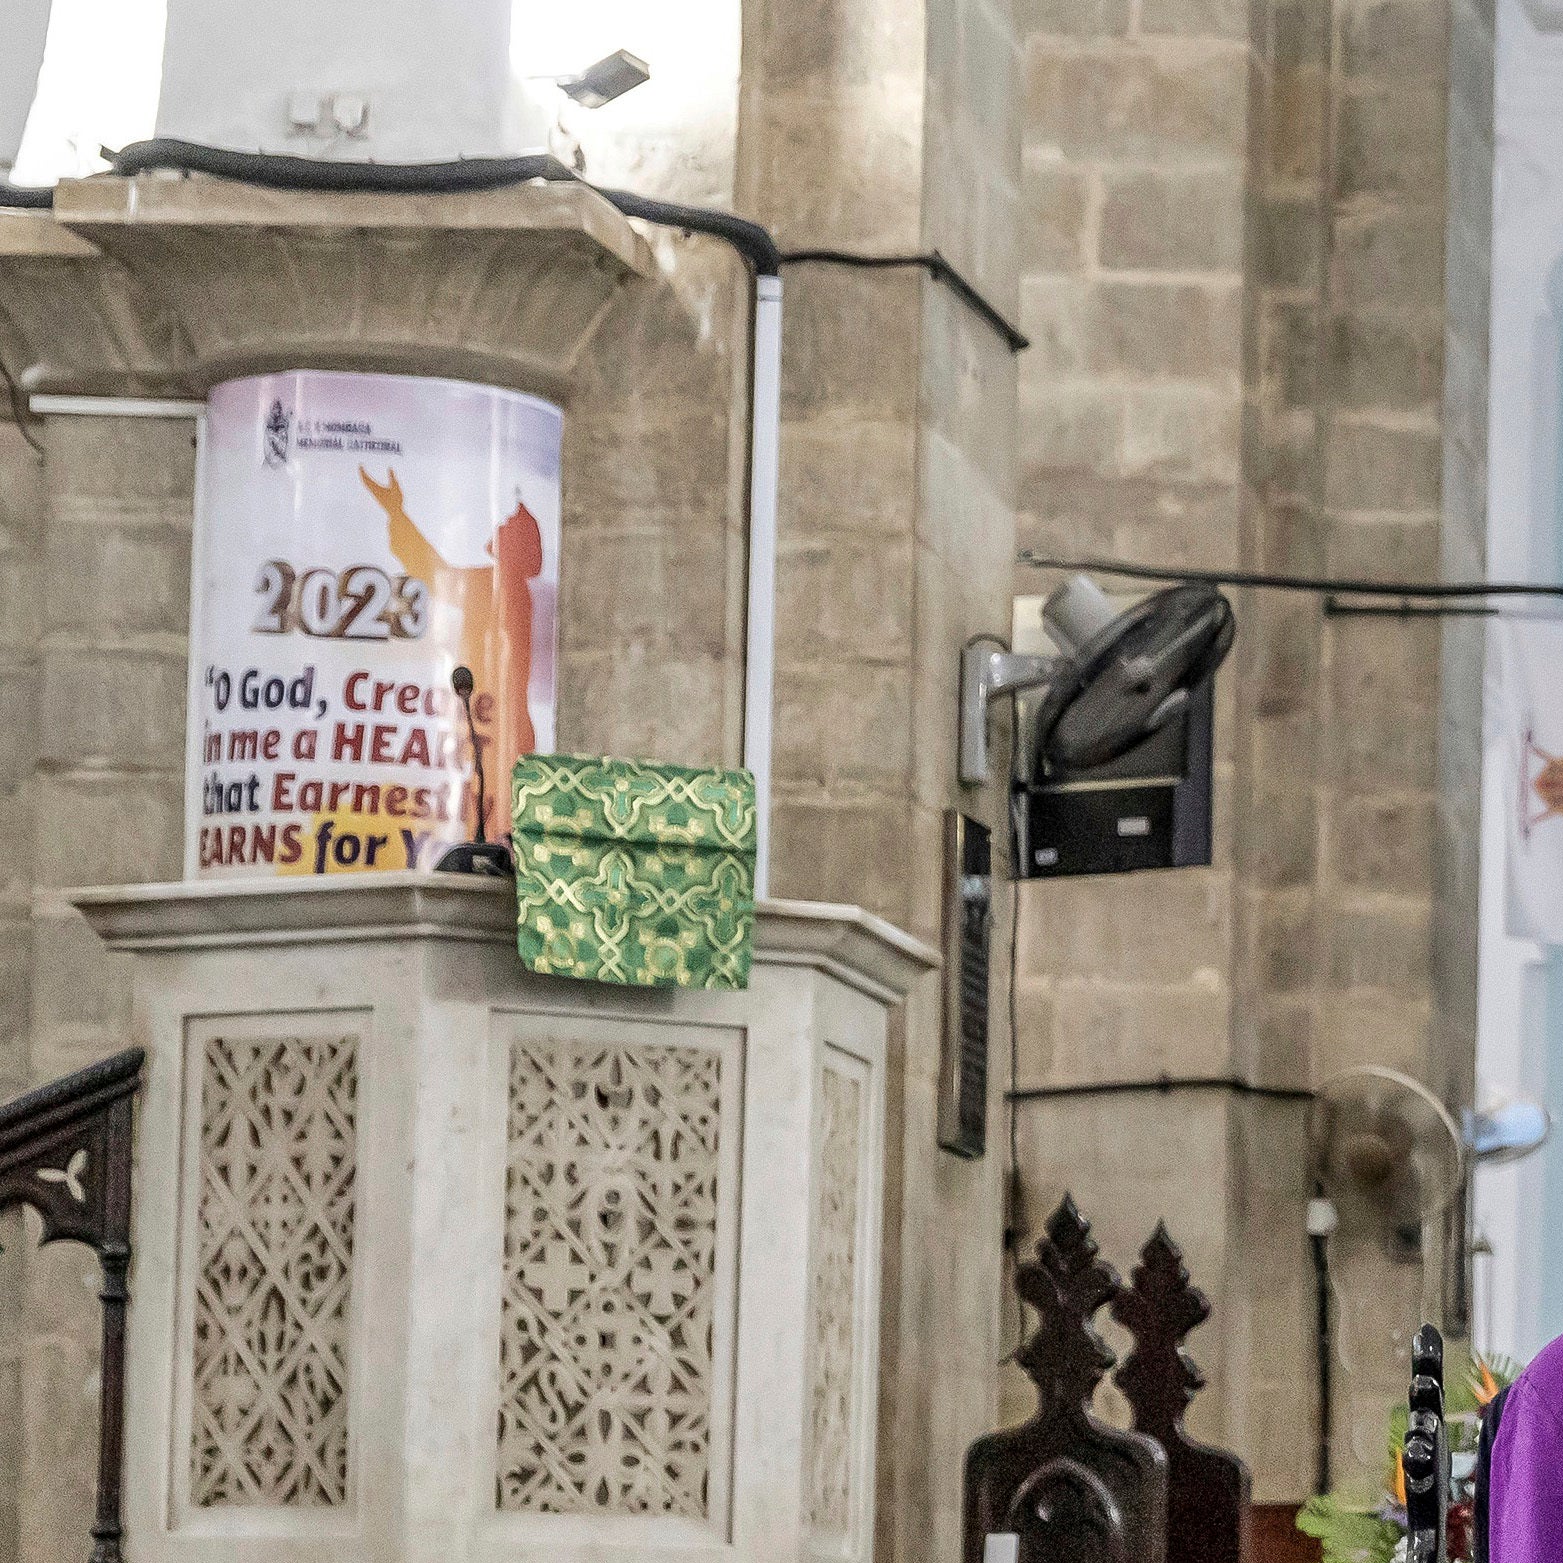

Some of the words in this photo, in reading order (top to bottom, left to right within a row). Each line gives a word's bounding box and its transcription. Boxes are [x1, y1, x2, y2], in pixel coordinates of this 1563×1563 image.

[252, 559, 430, 640] 2023
[241, 666, 327, 719] God,
[229, 729, 280, 761] me
[293, 729, 317, 761] a
[203, 772, 259, 815] that
[315, 820, 387, 873] for
